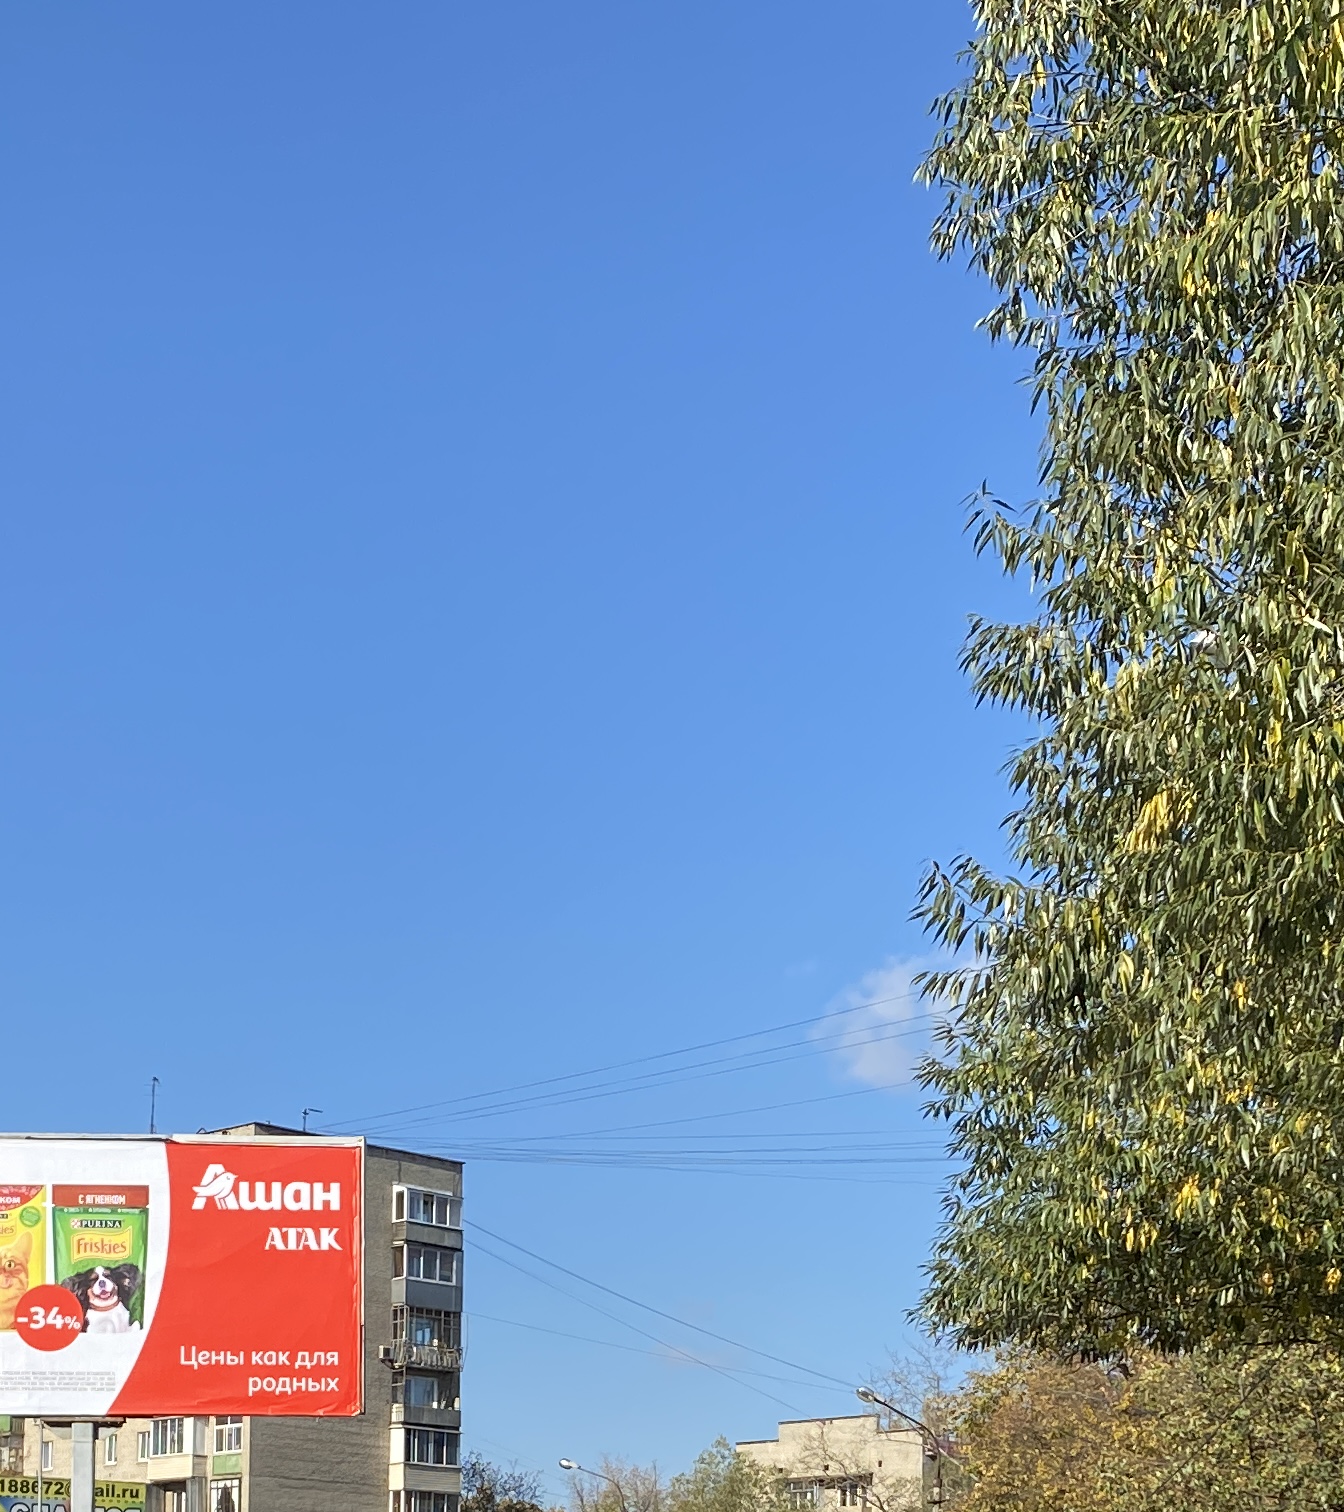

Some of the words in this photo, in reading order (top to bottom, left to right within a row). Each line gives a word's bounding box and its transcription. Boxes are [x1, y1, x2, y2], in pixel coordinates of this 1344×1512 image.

[192, 1164, 341, 1211] Ашан
[82, 1220, 122, 1228] PURINA
[76, 1237, 127, 1254] Friskies
[264, 1227, 343, 1251] АТАК
[16, 1306, 81, 1330] -34%
[179, 1345, 244, 1369] Цены
[251, 1351, 290, 1365] как
[294, 1351, 339, 1369] для
[248, 1376, 339, 1396] родных
